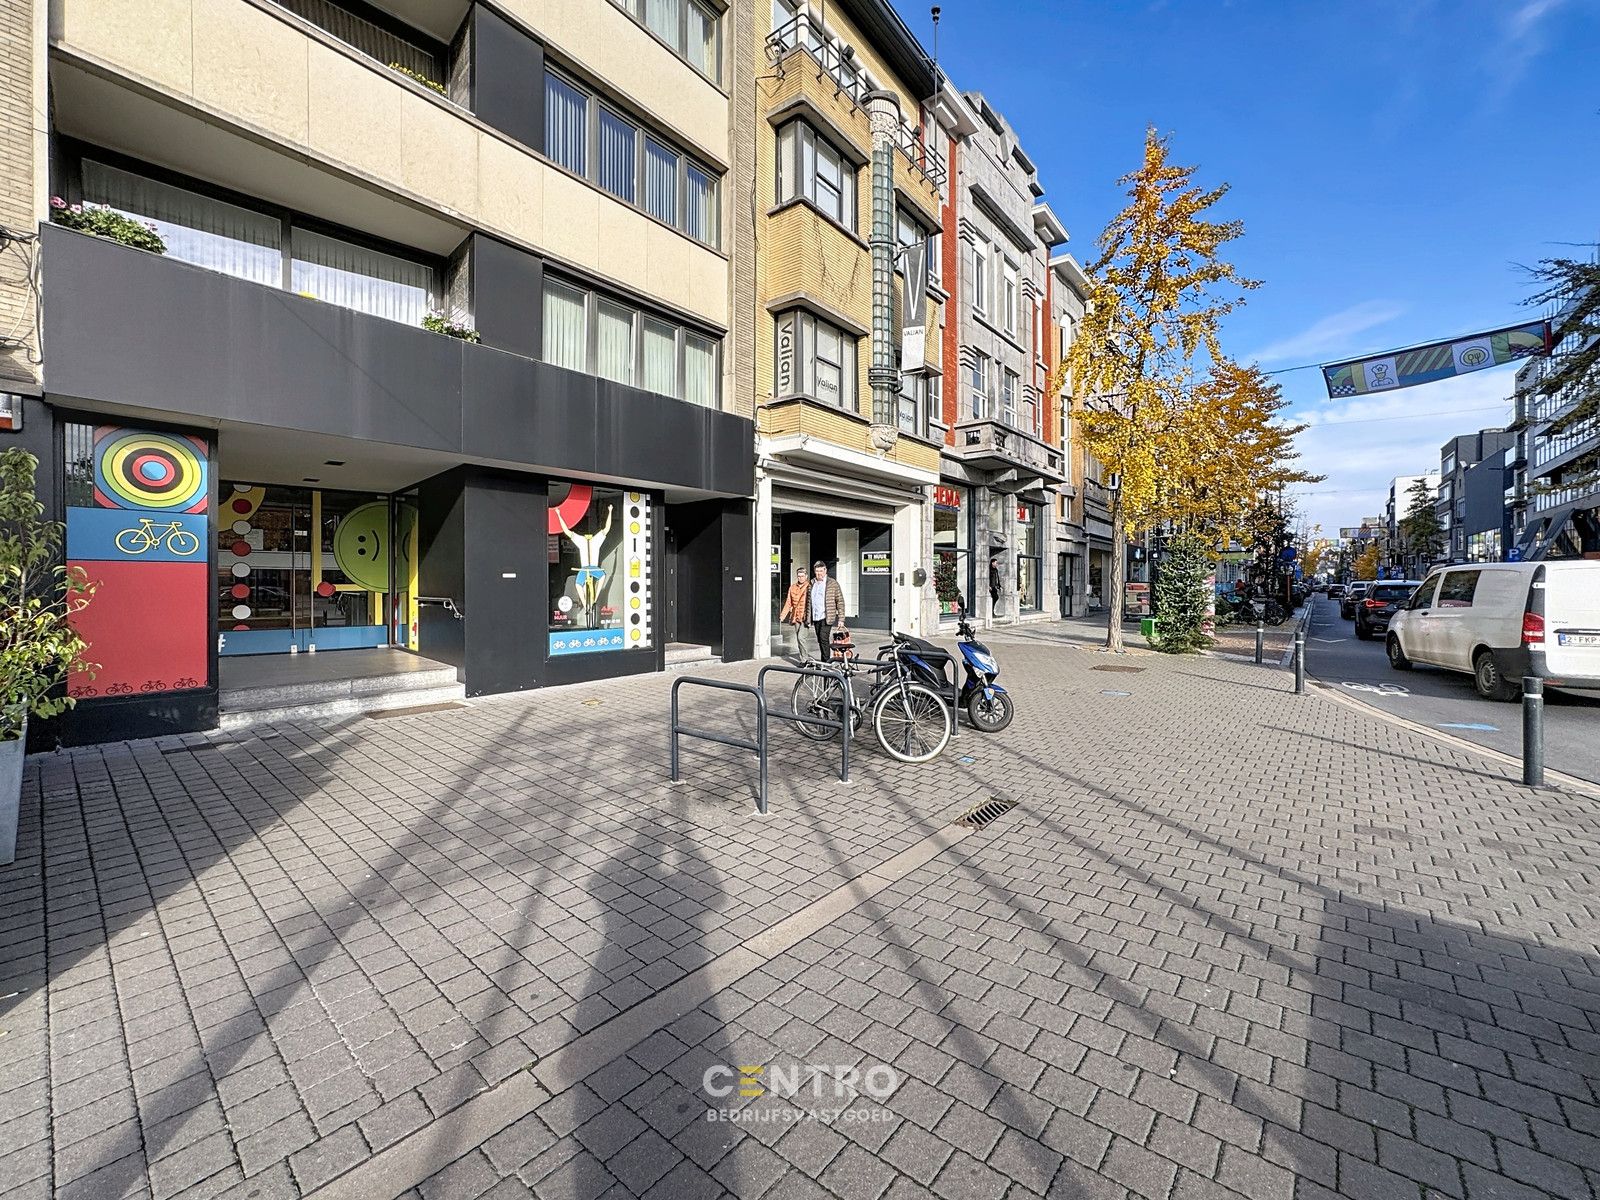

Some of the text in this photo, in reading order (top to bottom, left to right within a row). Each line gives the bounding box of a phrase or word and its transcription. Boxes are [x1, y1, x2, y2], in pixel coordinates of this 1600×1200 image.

[905, 249, 923, 320] V
[904, 328, 923, 337] VALIAN
[781, 320, 793, 387] Valian
[933, 485, 960, 507] HEMA
[1016, 507, 1030, 522] EMA
[1509, 549, 1519, 559] P
